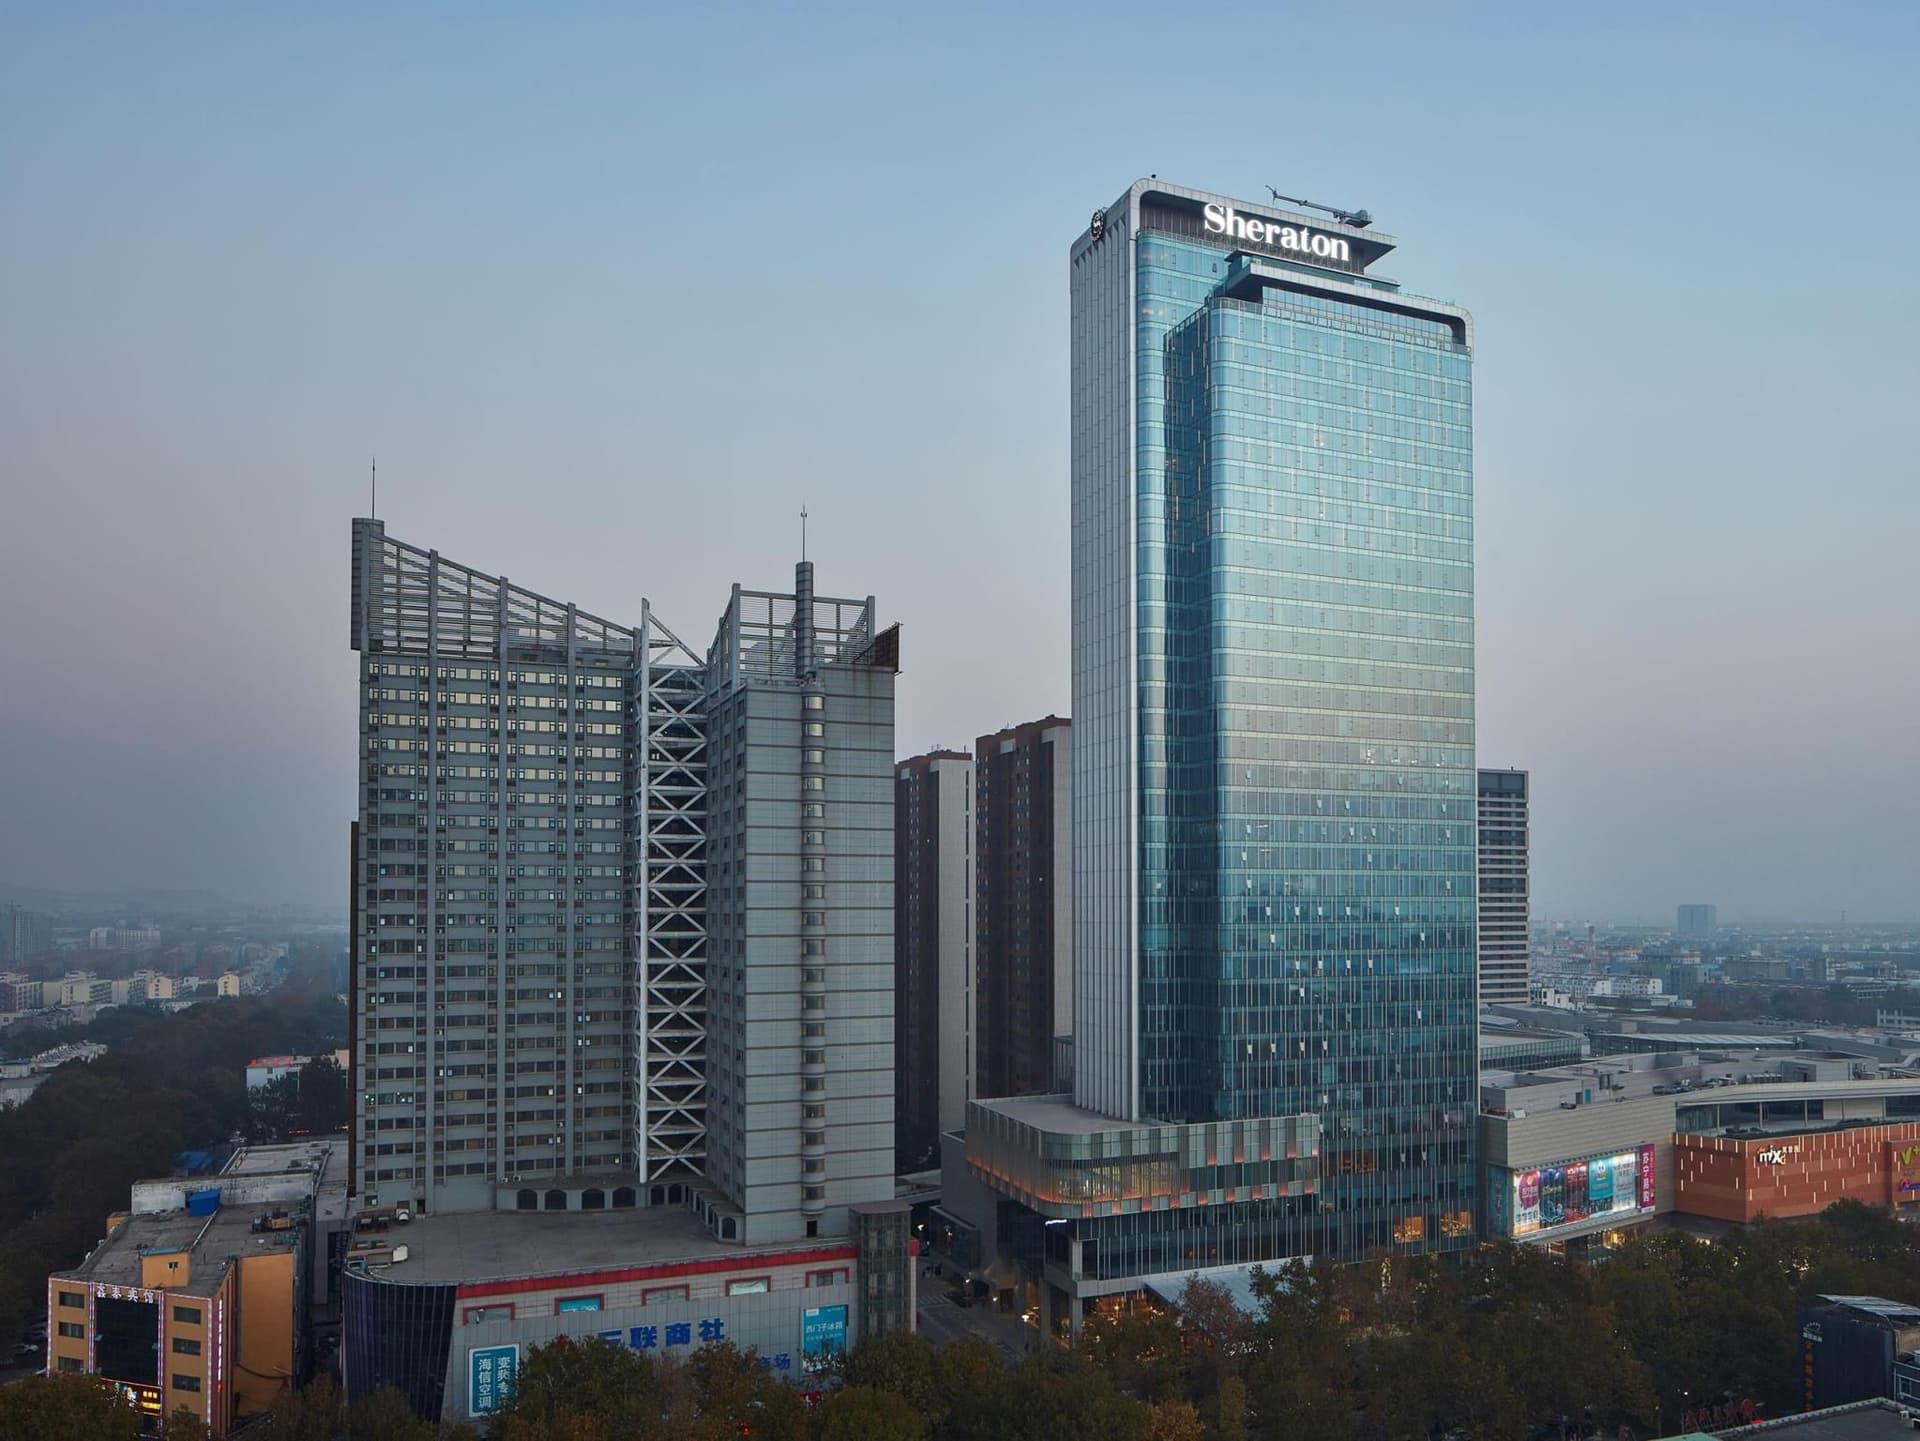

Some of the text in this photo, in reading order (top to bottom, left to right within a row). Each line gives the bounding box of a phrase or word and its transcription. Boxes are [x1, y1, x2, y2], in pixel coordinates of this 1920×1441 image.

[1203, 203, 1350, 262] Sheraton
[597, 1317, 726, 1349] 三联商社
[478, 1358, 492, 1409] 海信空调
